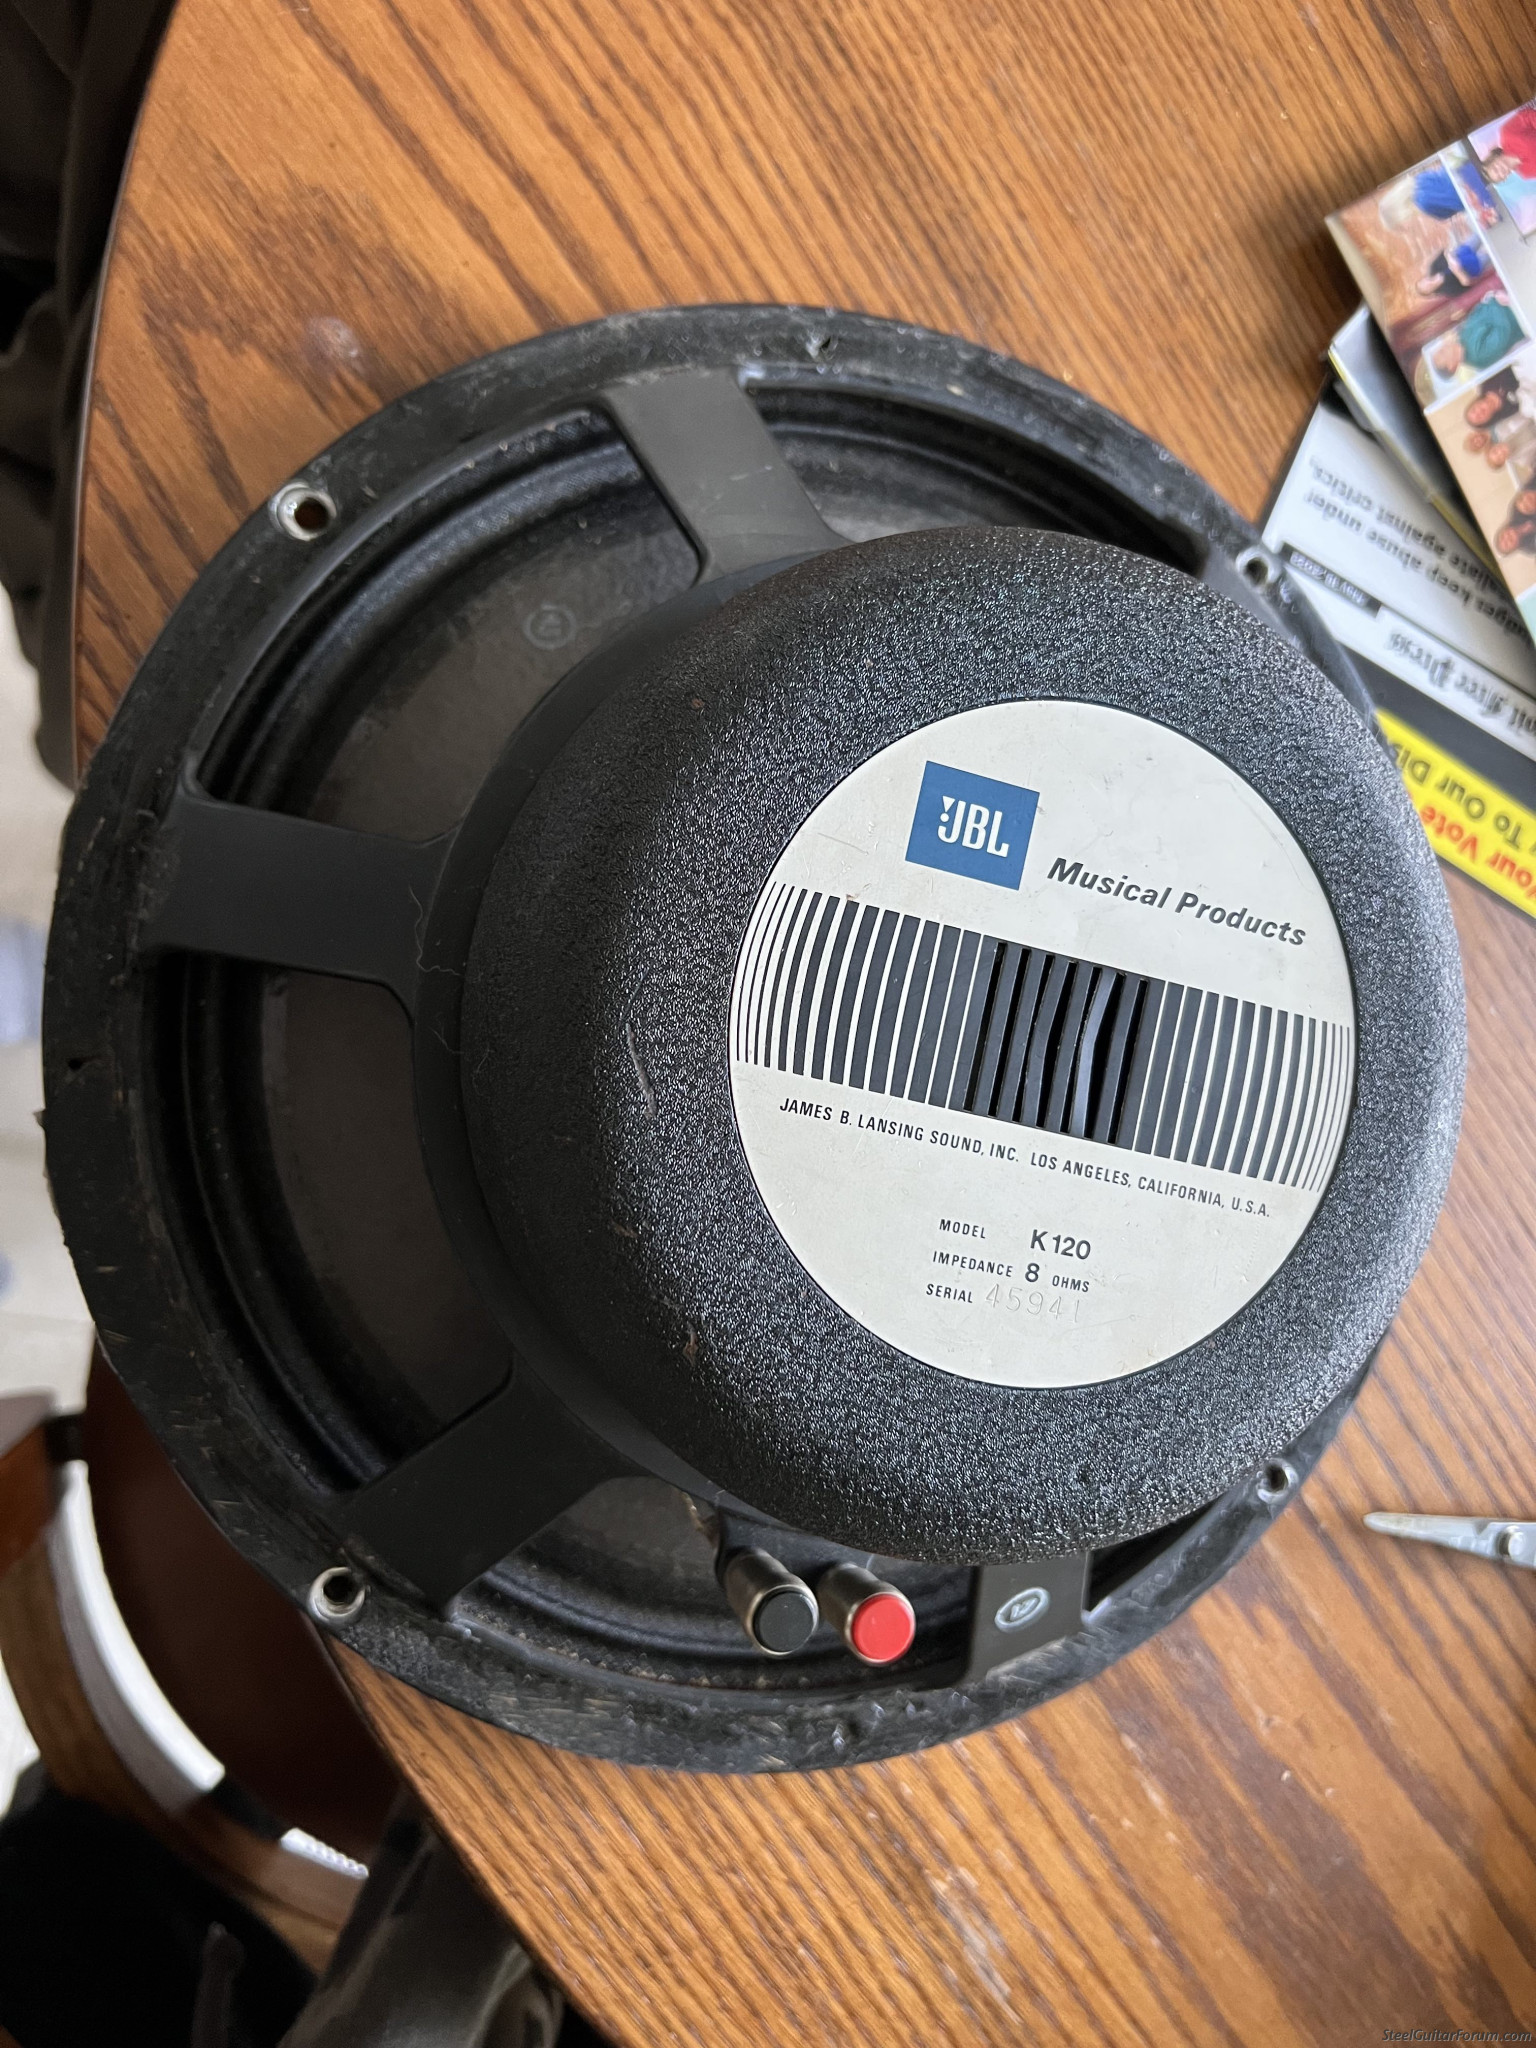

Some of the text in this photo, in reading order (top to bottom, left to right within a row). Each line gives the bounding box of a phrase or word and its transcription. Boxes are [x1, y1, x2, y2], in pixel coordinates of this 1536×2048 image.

[1437, 773, 1487, 820] Our
[937, 795, 1010, 858] JBL
[1420, 804, 1478, 863] Vote
[1492, 813, 1523, 850] To
[1046, 856, 1307, 947] Musical Products
[779, 1098, 1270, 1218] JAMES B. LANSING SOUND, INC. LOS ANGELES, CALIFORNIA, U.S.A.
[939, 1219, 1091, 1260] MODEL K120
[932, 1250, 1090, 1293] IMPEDANCE 8 OHMS
[926, 1283, 1080, 1323] SERIAL 45941
